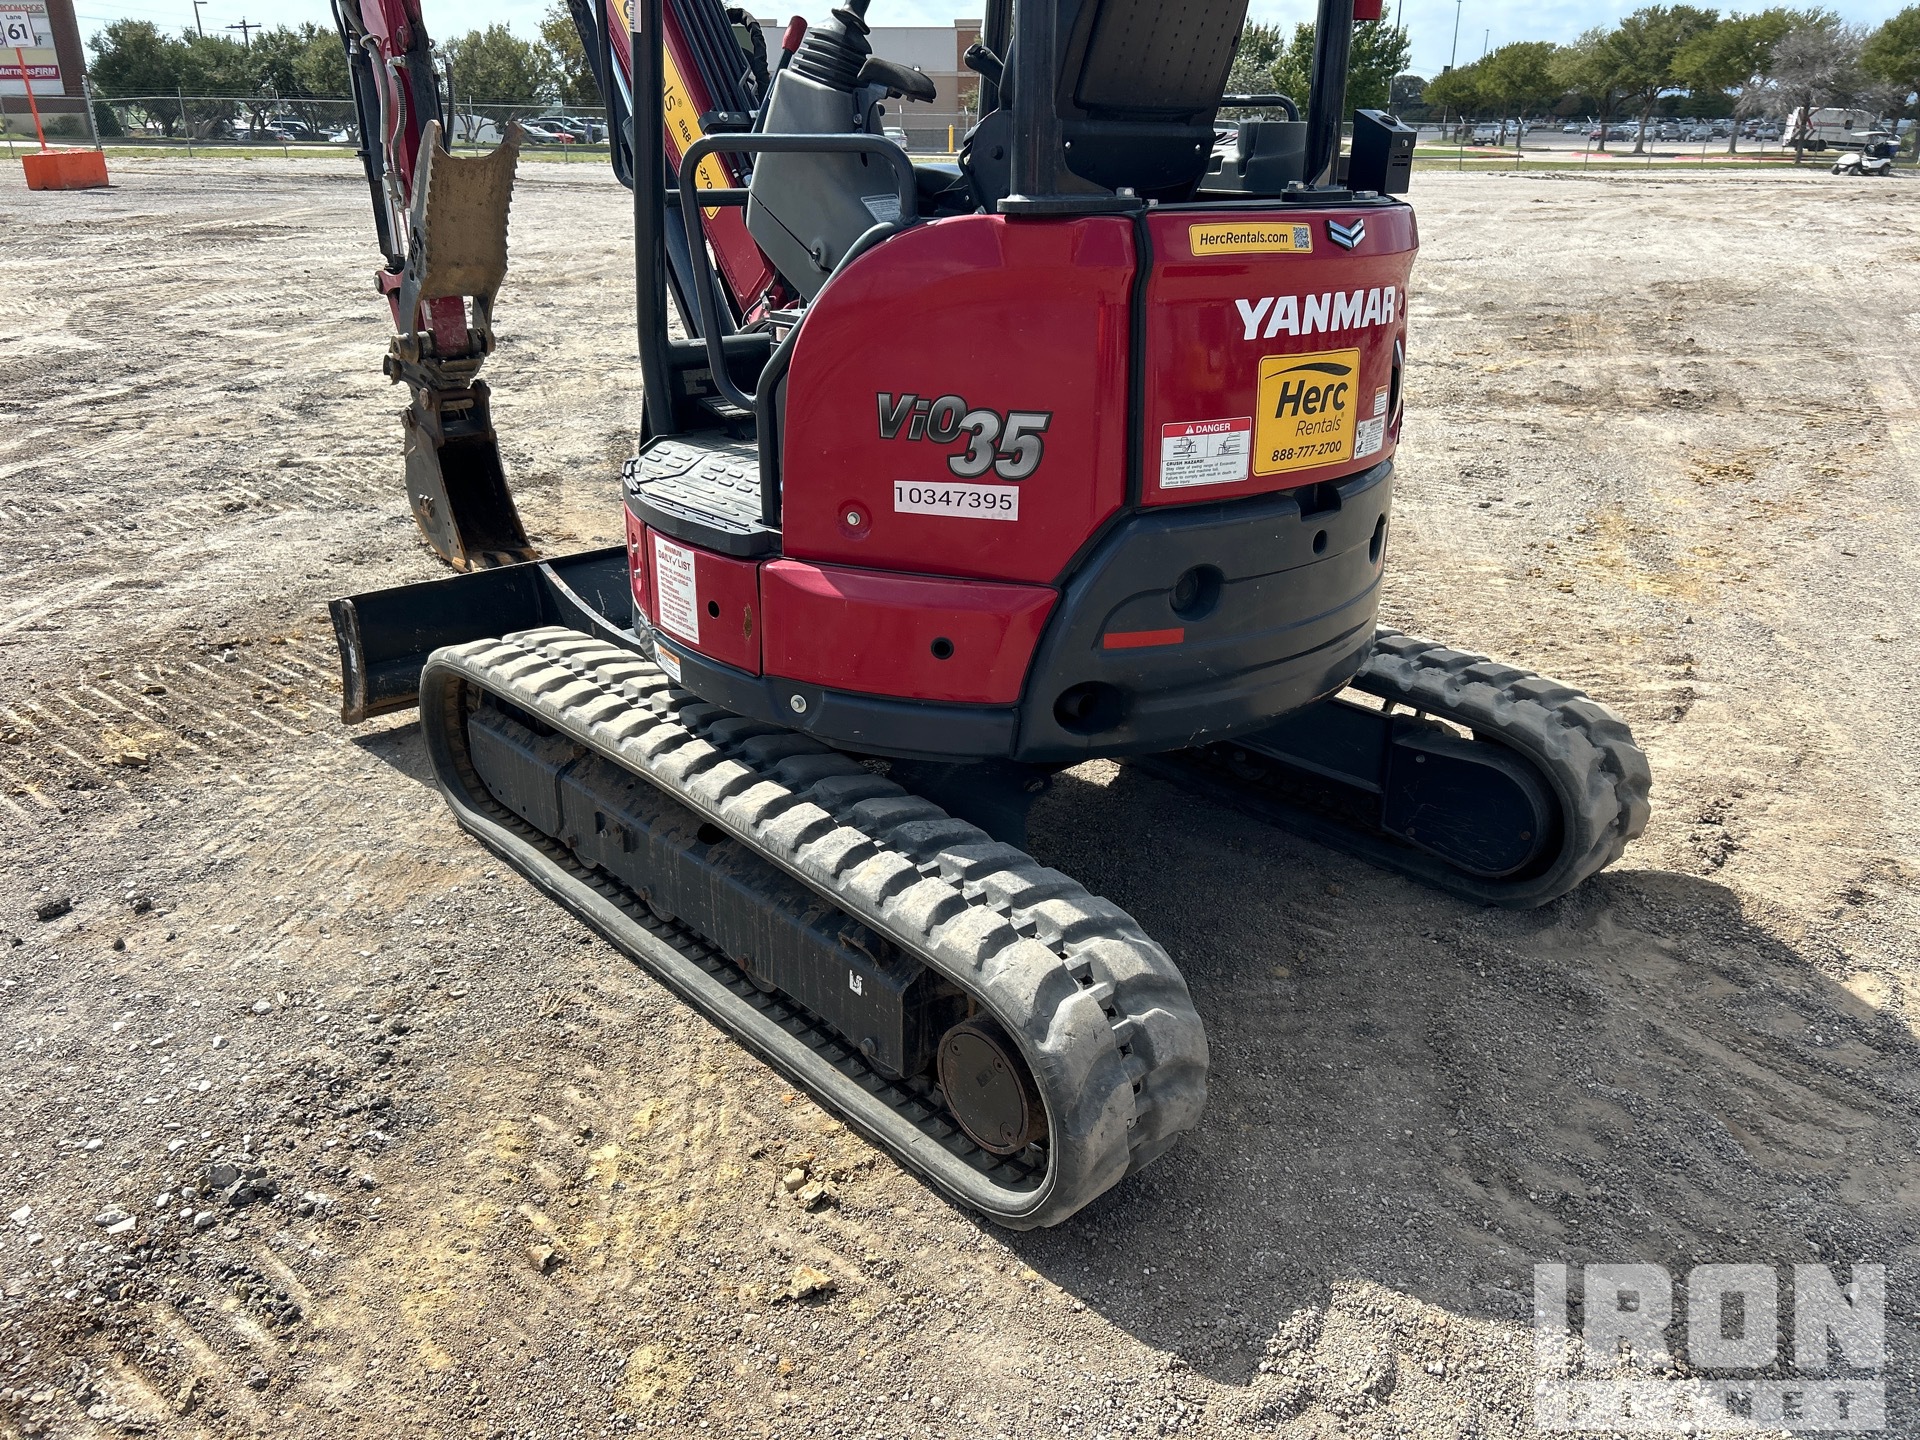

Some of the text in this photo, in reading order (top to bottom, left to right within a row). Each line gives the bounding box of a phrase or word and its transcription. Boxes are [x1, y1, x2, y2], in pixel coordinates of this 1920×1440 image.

[8, 23, 28, 40] 61
[1200, 231, 1288, 246] HercRentals.com
[1235, 286, 1396, 340] YANMAR
[1275, 379, 1348, 418] Herc
[1196, 423, 1231, 433] DANGER
[1296, 416, 1340, 437] Rentals
[1272, 441, 1342, 462] 888-777-2700
[896, 486, 1012, 510] 10347395
[658, 550, 691, 572] DAILY LIST
